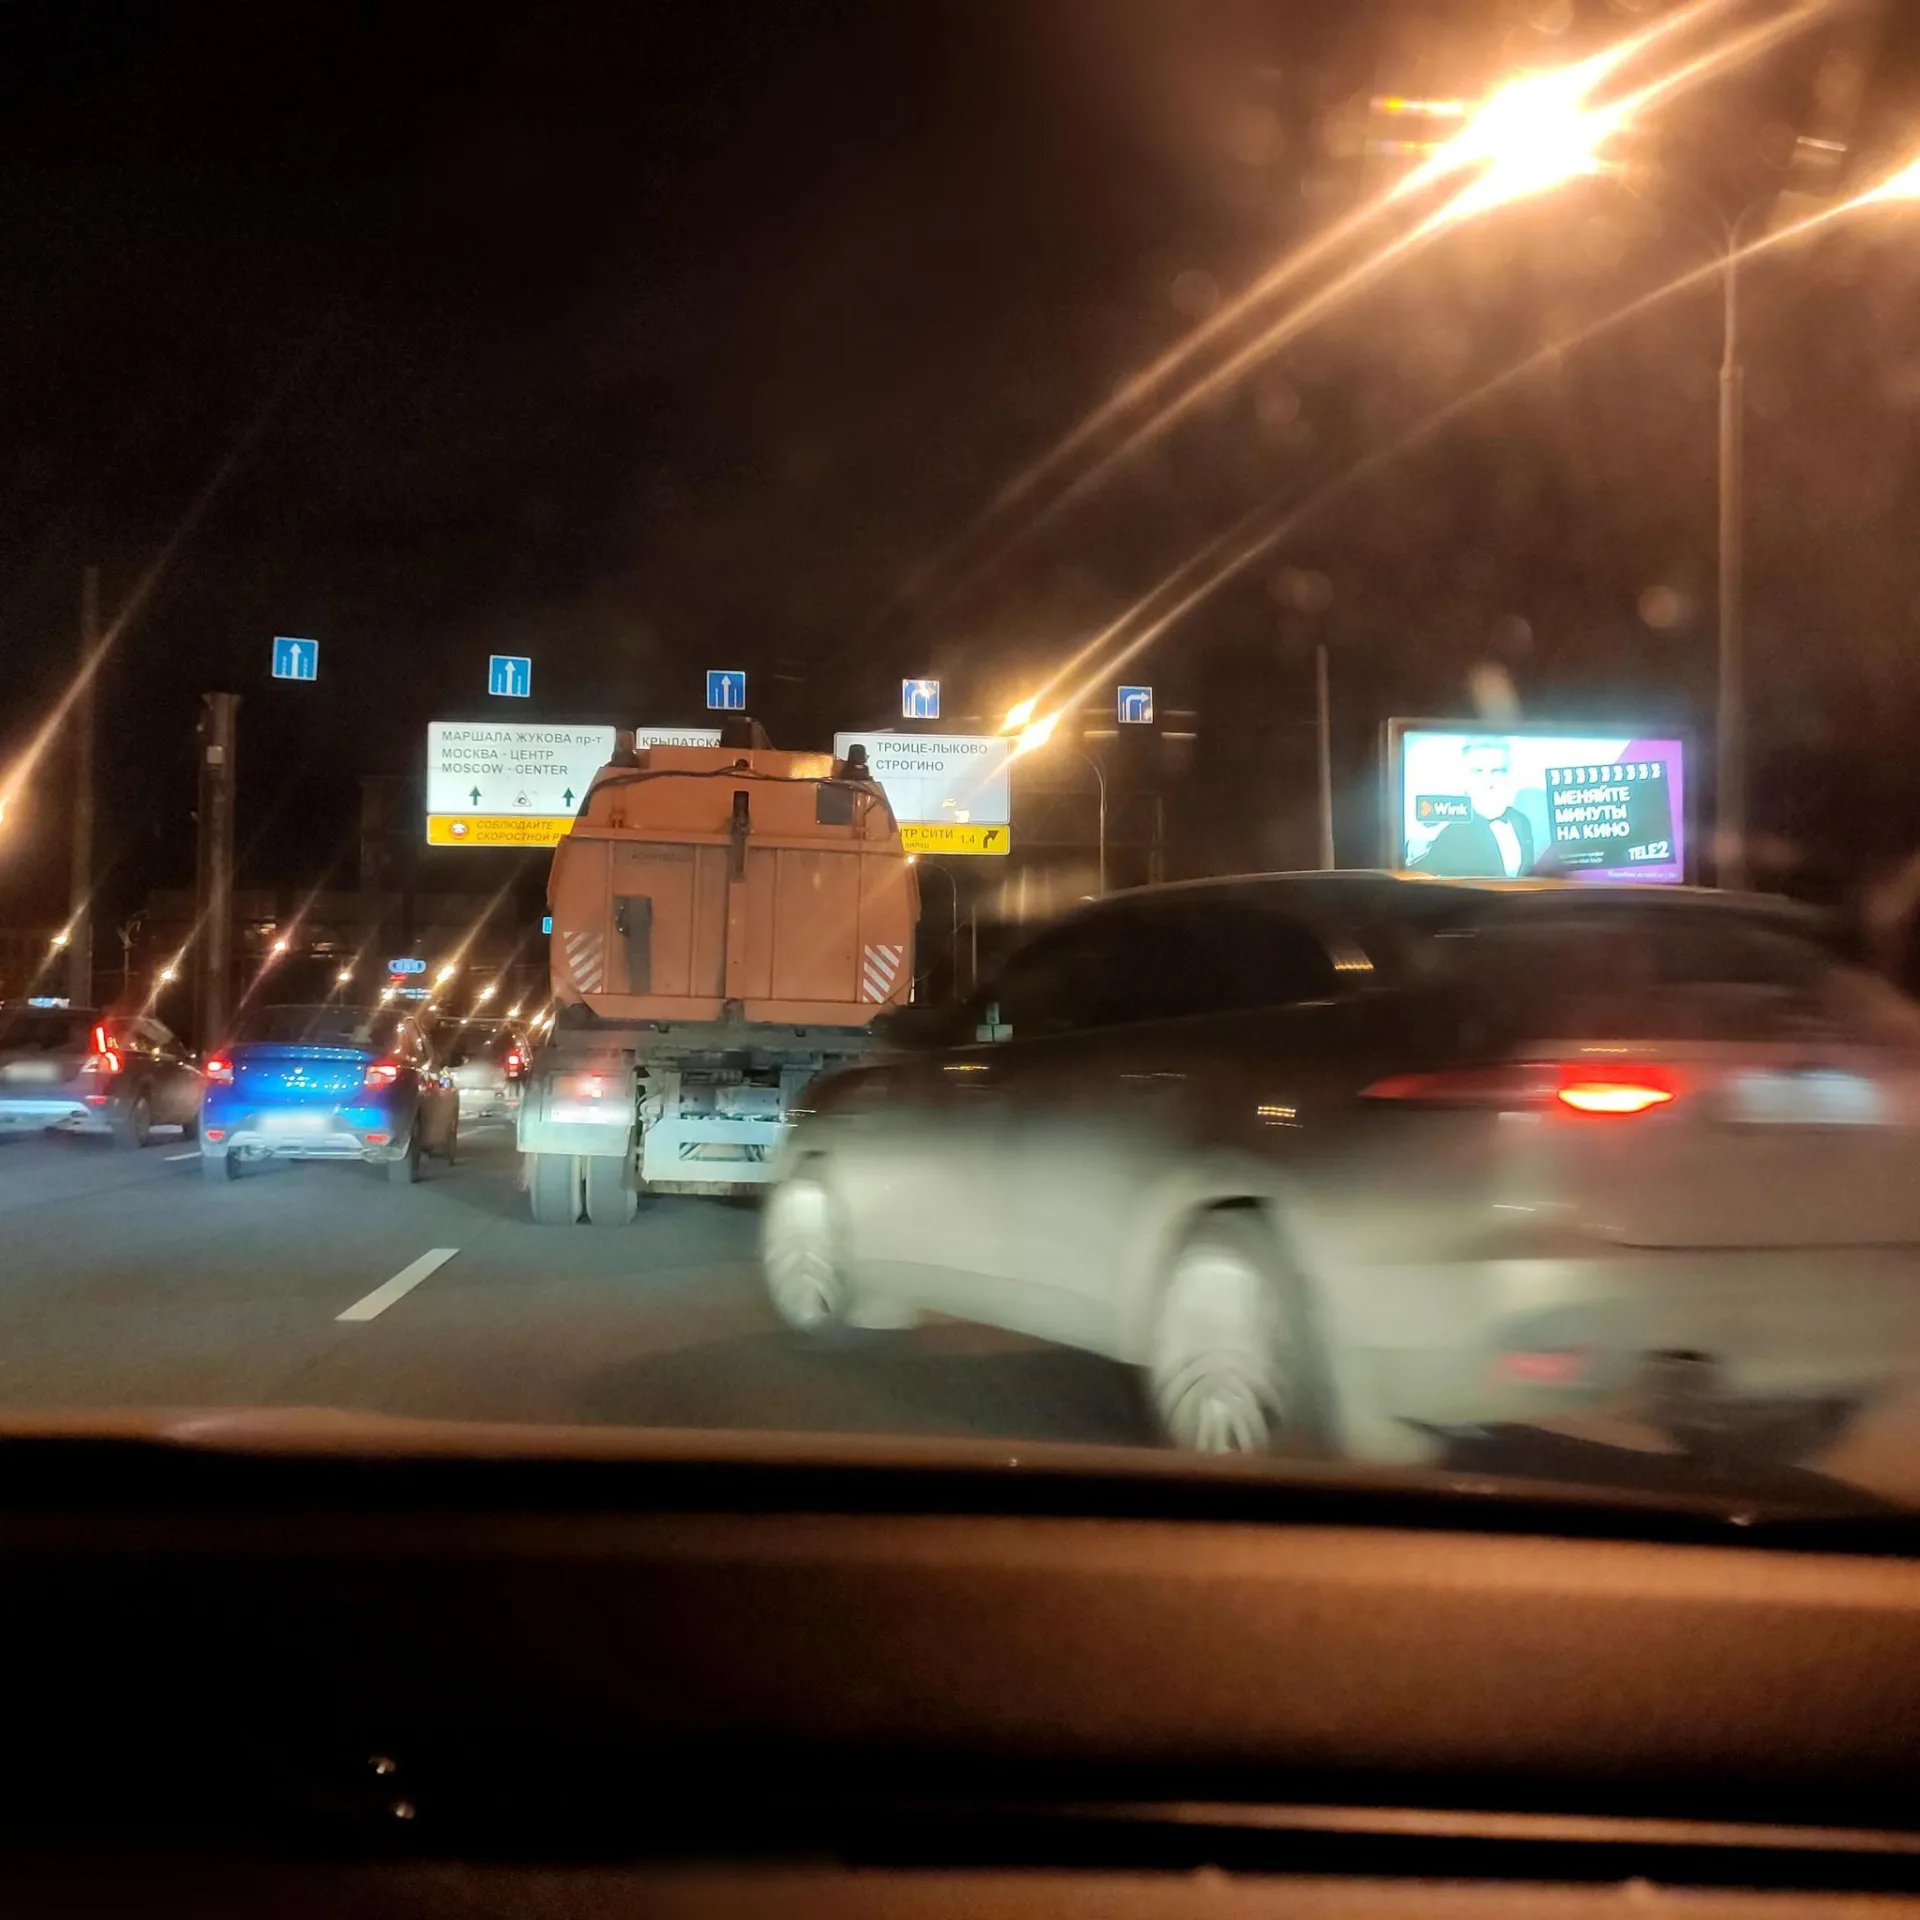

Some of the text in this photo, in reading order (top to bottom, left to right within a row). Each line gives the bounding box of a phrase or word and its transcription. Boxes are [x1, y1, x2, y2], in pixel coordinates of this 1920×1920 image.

[441, 731, 603, 747] МАРШАЛА ЖУКОВА пр-т
[441, 748, 498, 760] МОСКВА
[510, 749, 554, 762] ЦЕНТР
[877, 741, 988, 755] ТРОИЦЕ-ЛЫКОВО
[441, 763, 503, 775] MOSCOW
[516, 764, 568, 775] CENTER
[876, 760, 944, 771] СТРОГИНО
[1553, 785, 1631, 808] МЕНЯЙТЕ
[1434, 801, 1469, 817] Wink
[1555, 804, 1628, 824] МИНУТЫ
[477, 831, 550, 841] СКОРОСТНОЙ
[921, 829, 954, 839] СИТИ
[961, 834, 975, 844] 1.4
[1556, 821, 1631, 841] НА КИНО
[1628, 841, 1670, 861] TELE2
